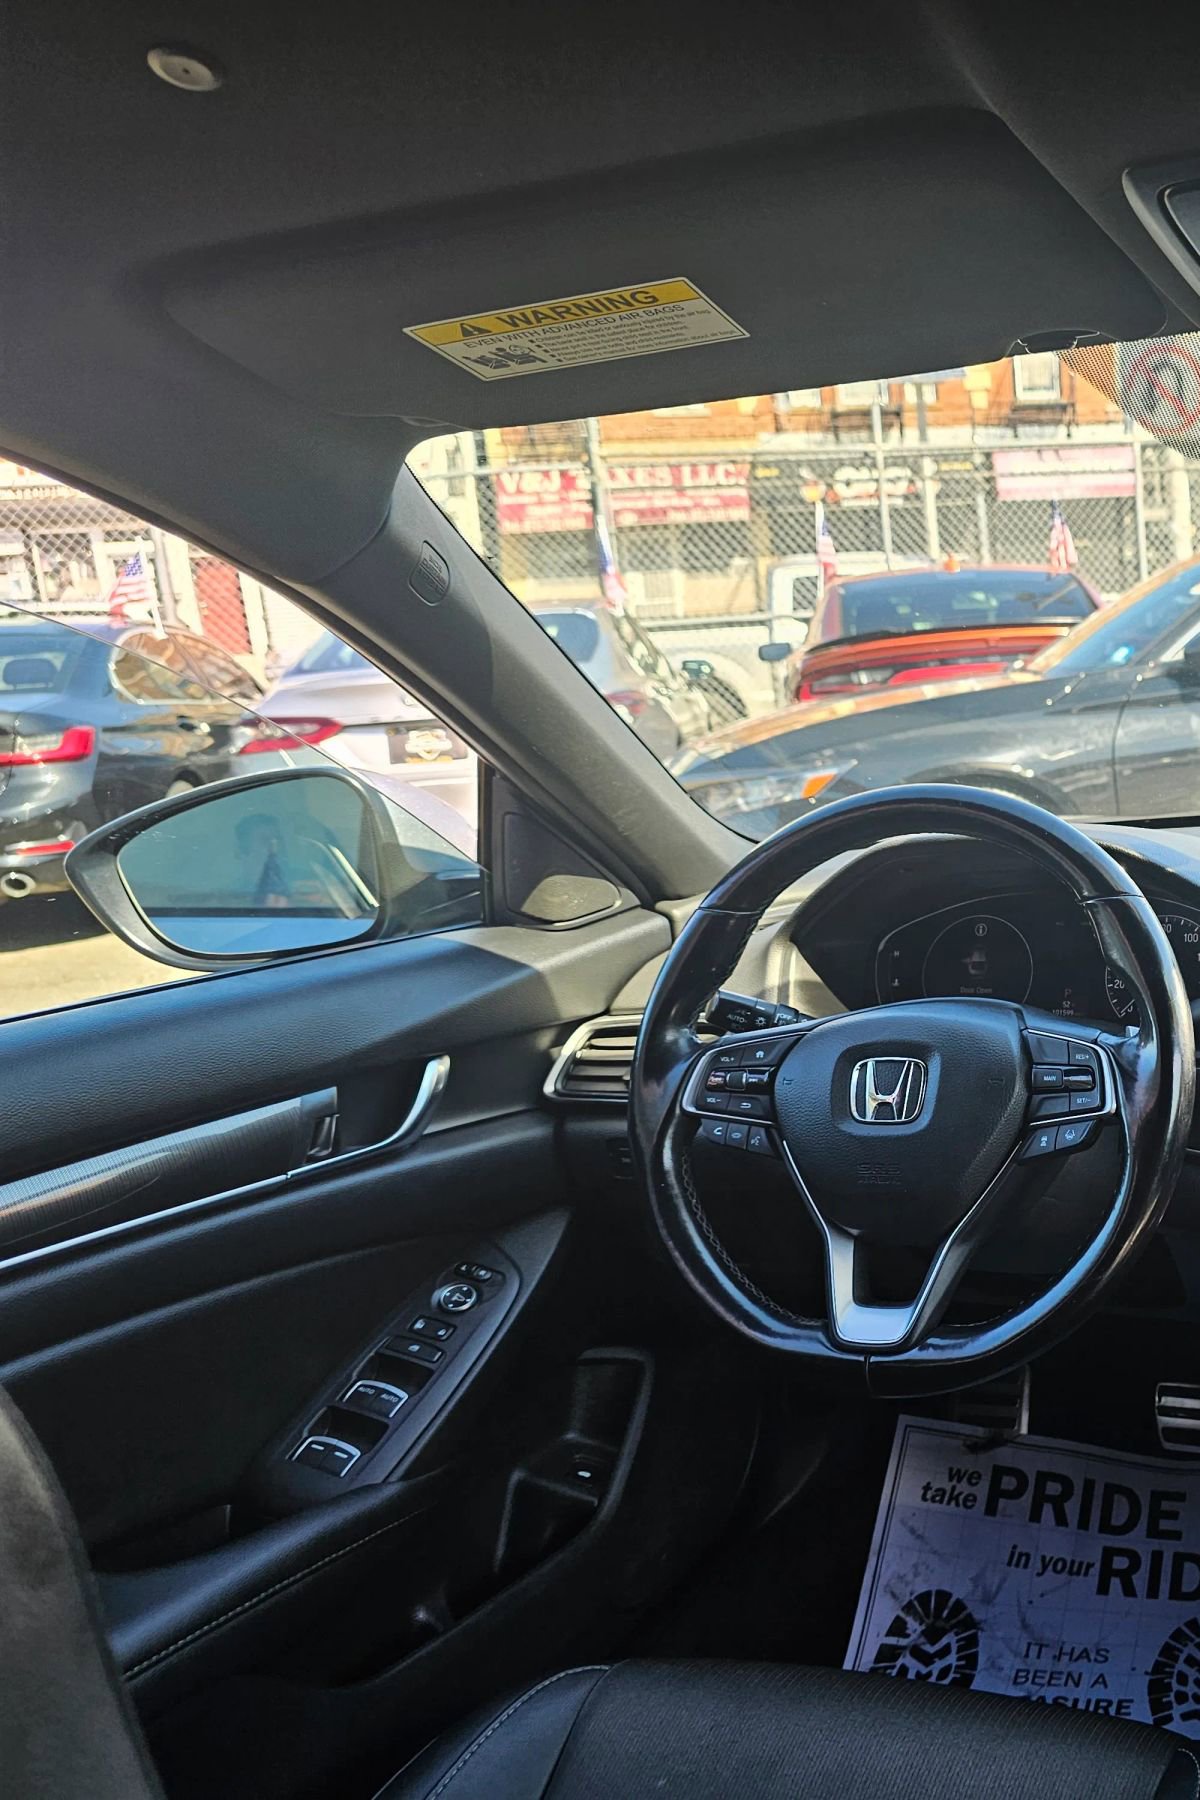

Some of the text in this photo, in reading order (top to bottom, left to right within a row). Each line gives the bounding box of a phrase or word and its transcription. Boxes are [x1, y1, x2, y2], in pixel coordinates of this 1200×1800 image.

[495, 290, 660, 328] WARNING
[462, 334, 505, 349] EVEN
[503, 328, 541, 342] WITH
[541, 315, 617, 336] ADVANCED
[619, 311, 642, 322] AIR
[642, 303, 685, 317] BAGS
[1184, 933, 1199, 943] 100
[726, 1014, 746, 1023] AUTO
[947, 1465, 982, 1486] we
[920, 1463, 1187, 1542] take PRIDE
[1006, 1544, 1032, 1569] in
[1035, 1552, 1096, 1578] your
[1023, 1641, 1111, 1664] IT HAS
[1012, 1668, 1108, 1689] BEEN A
